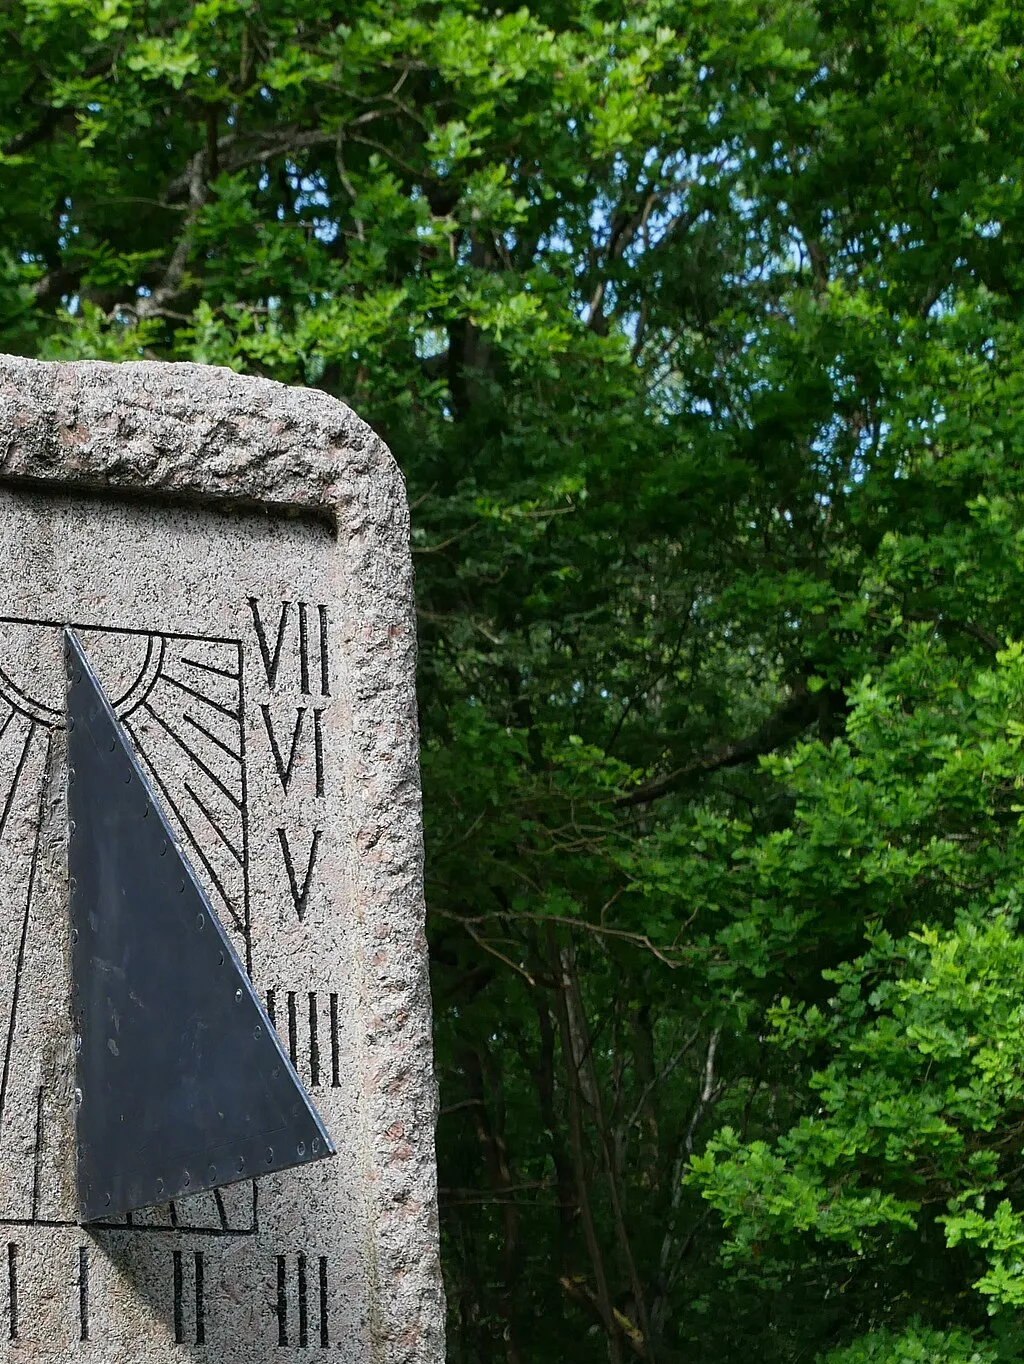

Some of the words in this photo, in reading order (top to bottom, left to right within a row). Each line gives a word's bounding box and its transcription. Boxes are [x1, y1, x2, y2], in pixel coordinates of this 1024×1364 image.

[246, 596, 331, 697] VII
[259, 703, 326, 798] VI
[277, 828, 324, 922] V
[79, 1246, 89, 1342] I
[173, 1249, 206, 1345] II
[276, 1254, 329, 1349] III
